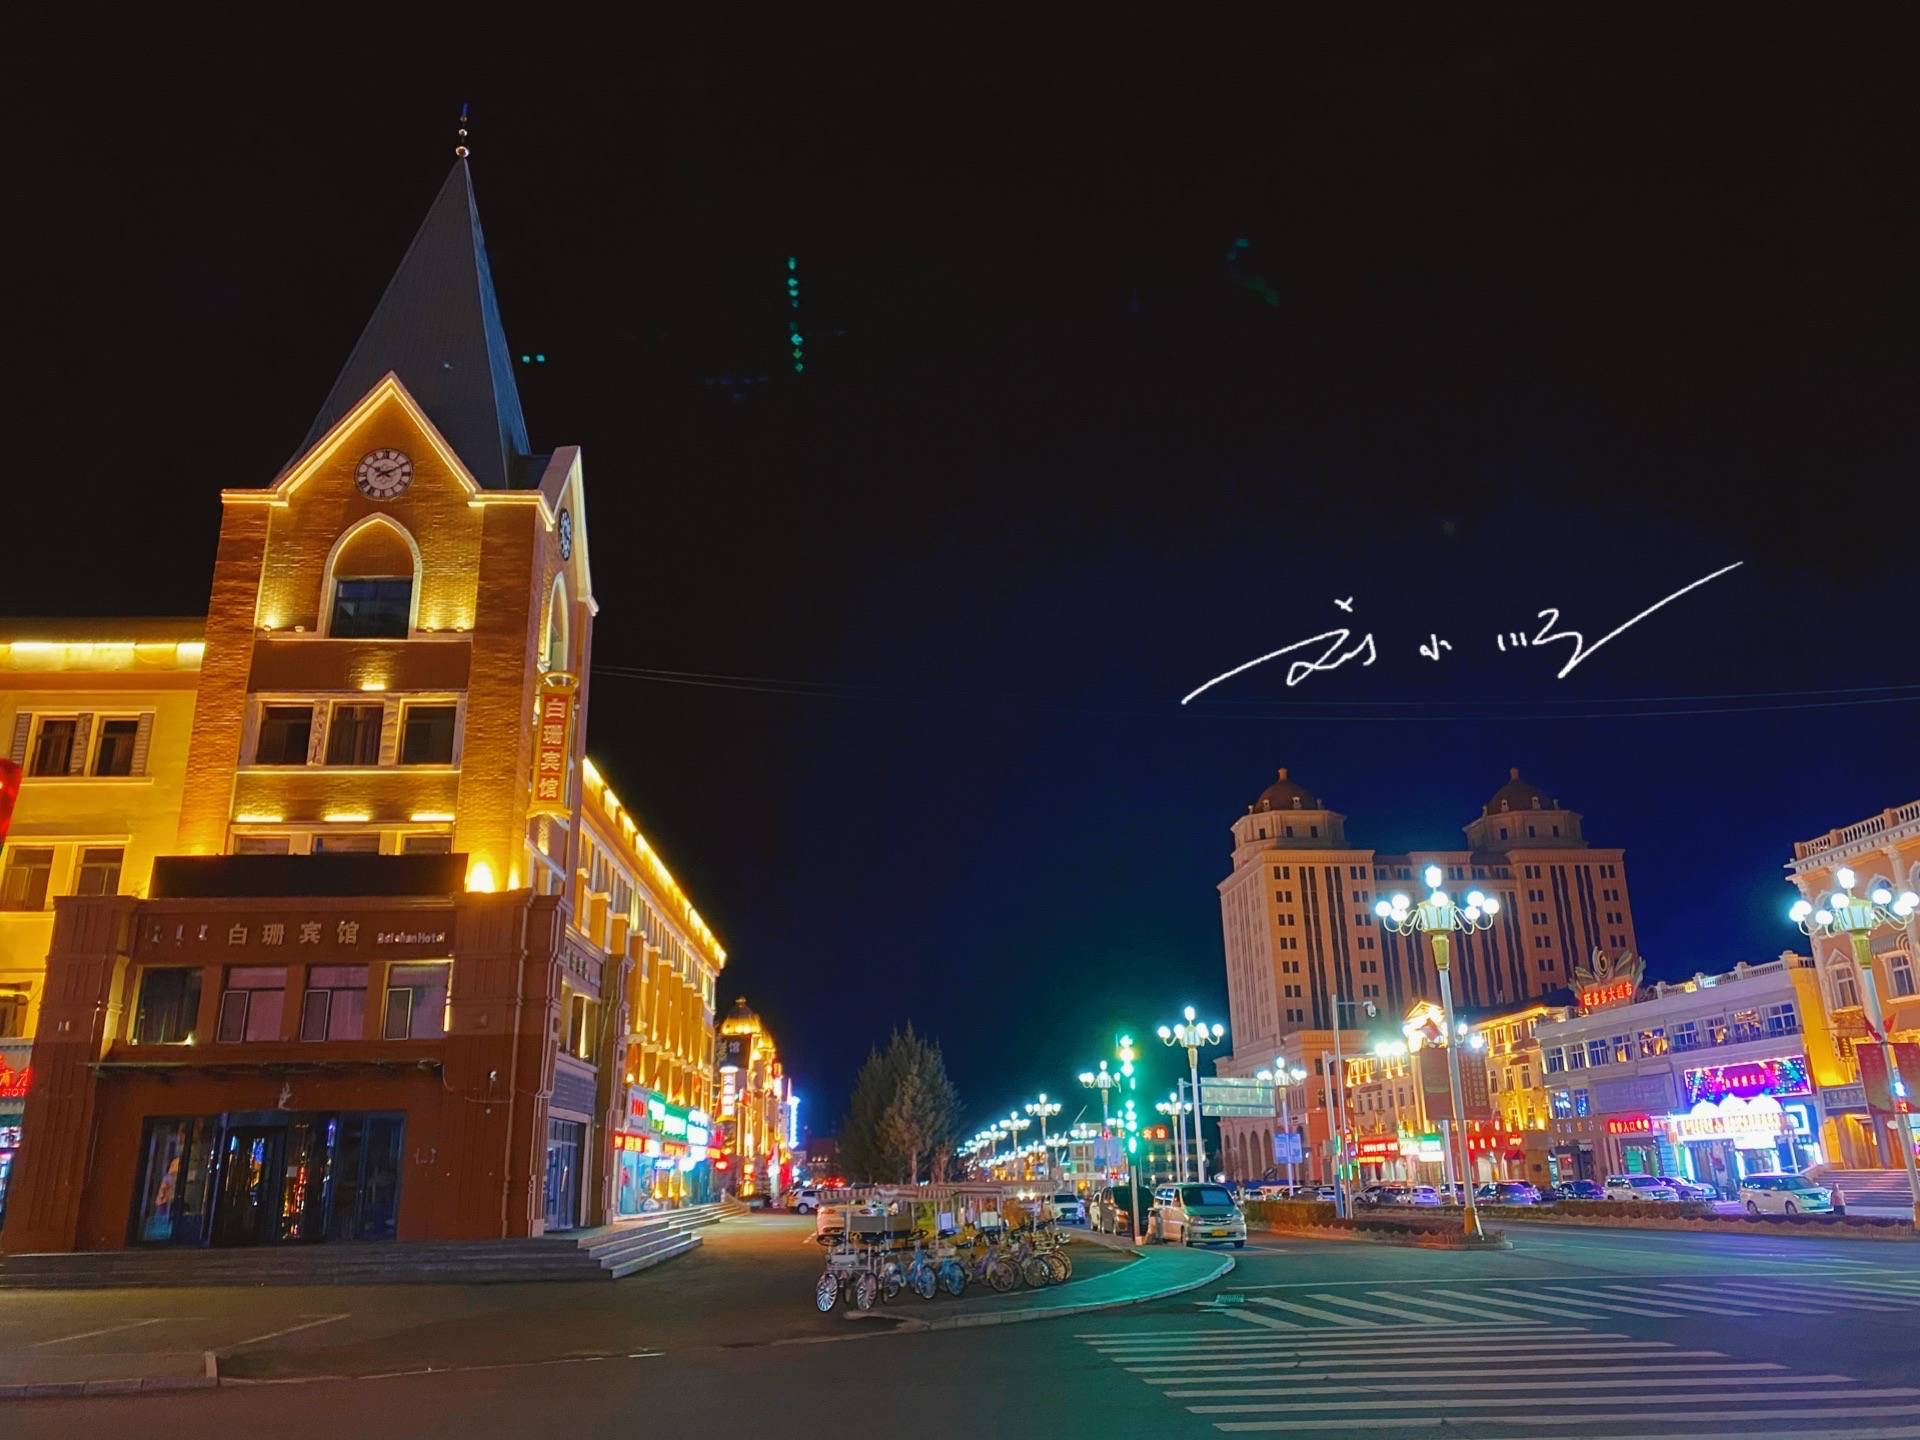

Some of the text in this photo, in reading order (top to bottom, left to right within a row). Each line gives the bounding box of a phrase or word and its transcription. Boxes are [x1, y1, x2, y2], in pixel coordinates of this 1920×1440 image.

[539, 697, 566, 797] 白珊宾馆
[228, 920, 360, 946] 白珊宾馆
